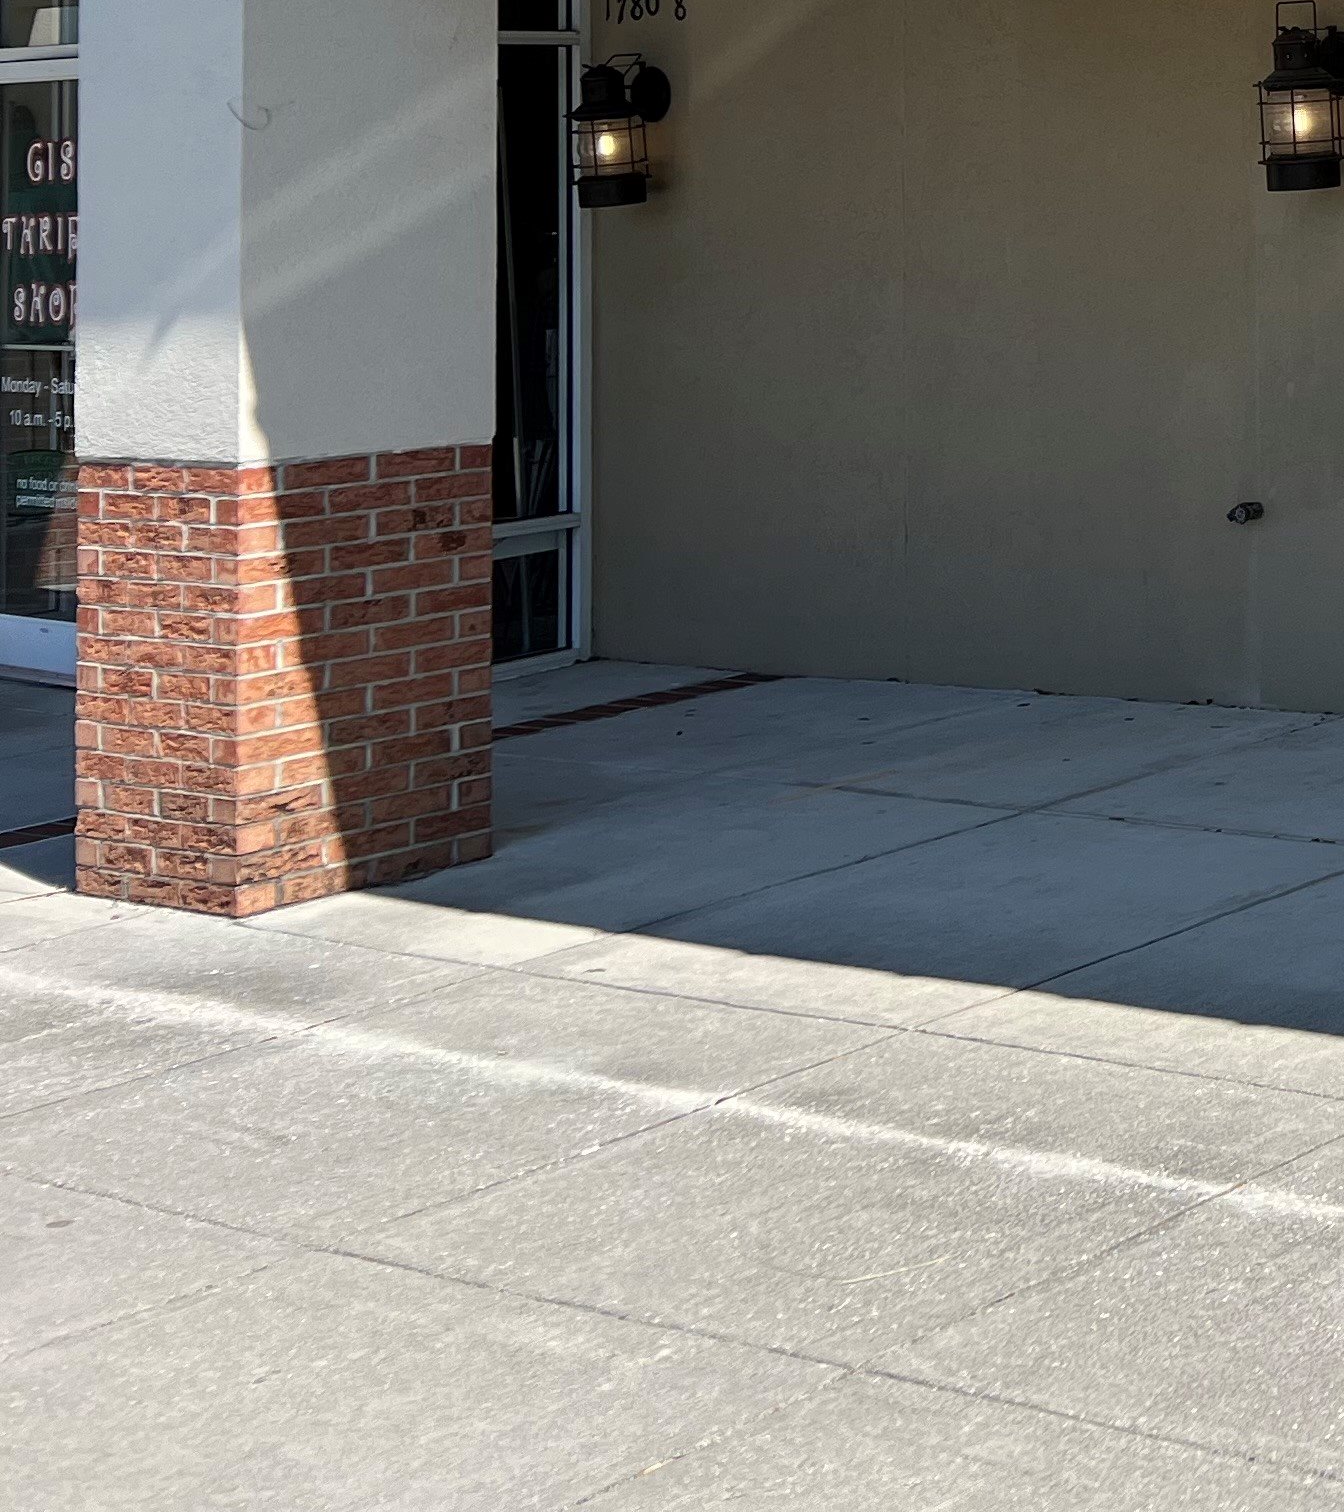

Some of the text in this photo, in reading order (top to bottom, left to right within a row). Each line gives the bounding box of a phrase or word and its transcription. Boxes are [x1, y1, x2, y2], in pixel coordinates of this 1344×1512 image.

[2, 216, 77, 259] THRIF
[1, 376, 42, 397] Monday
[50, 377, 75, 394] Satu
[9, 409, 22, 426] 10
[54, 411, 62, 427] 5
